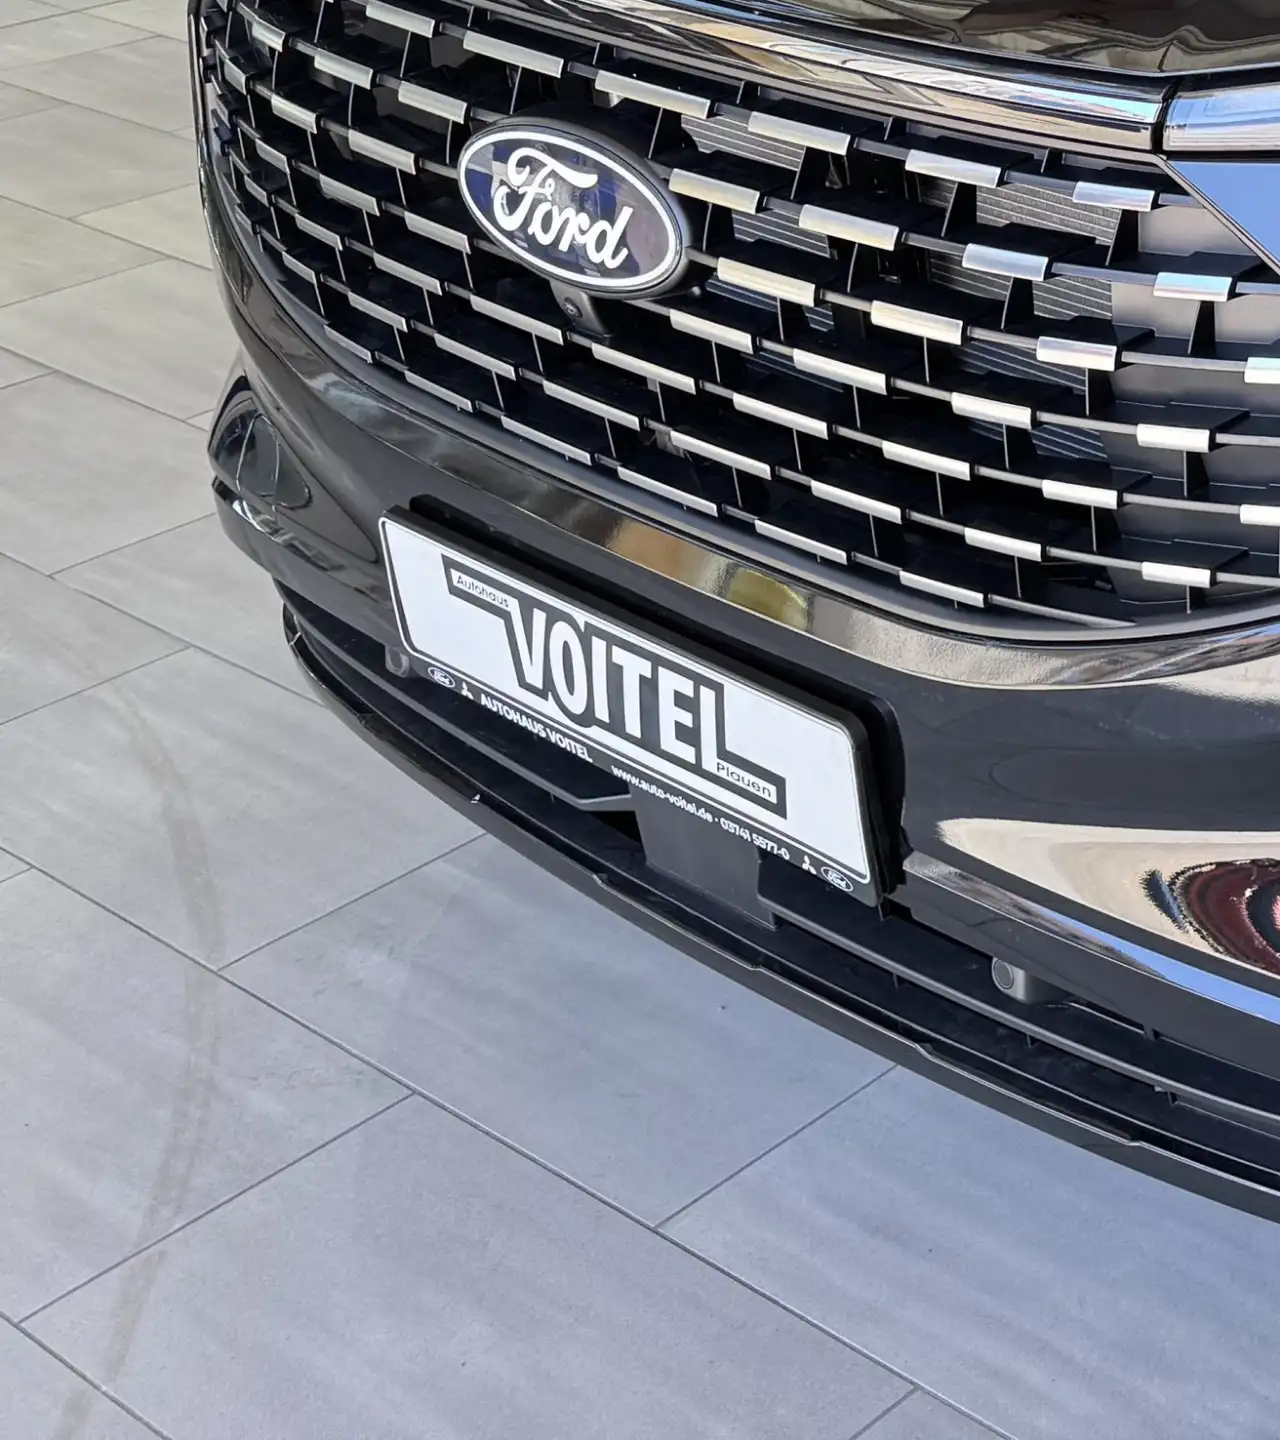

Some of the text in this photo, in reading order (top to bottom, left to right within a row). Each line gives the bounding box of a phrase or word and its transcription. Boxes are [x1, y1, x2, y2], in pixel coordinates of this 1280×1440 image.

[493, 146, 634, 270] Ford
[456, 574, 510, 608] Autohaus
[508, 598, 719, 772] VOITEL
[480, 693, 546, 737] AUTOHAUS
[546, 727, 594, 764] VOITEL
[610, 765, 714, 823] www.auto-voitel.de
[752, 832, 790, 861] 5577-0
[716, 762, 772, 800] Plauen
